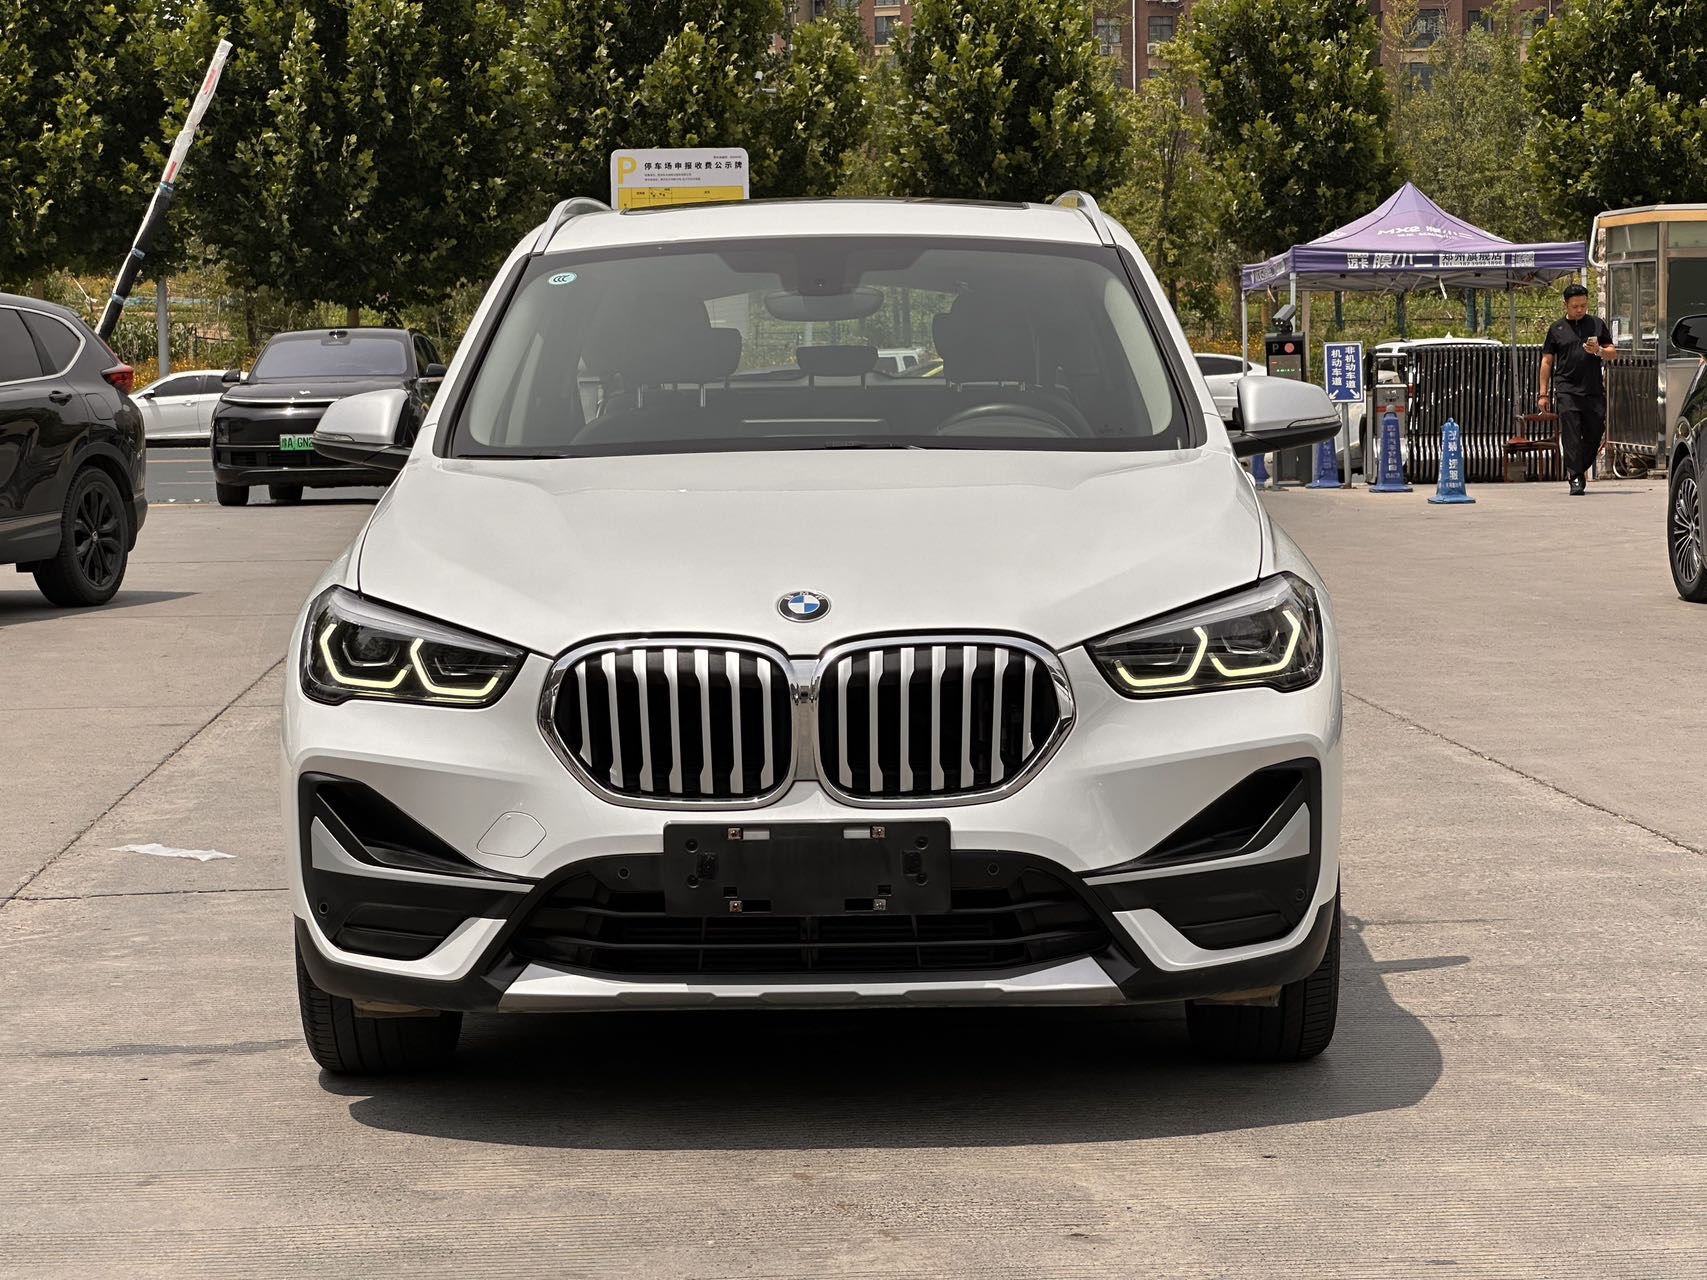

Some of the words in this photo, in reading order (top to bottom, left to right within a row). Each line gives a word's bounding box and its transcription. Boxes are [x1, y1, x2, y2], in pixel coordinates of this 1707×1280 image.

[618, 157, 637, 184] P
[644, 161, 743, 170] 停车场申报收费公示牌
[1373, 253, 1434, 269] 膜小二
[1272, 343, 1280, 353] P
[1331, 349, 1342, 386] 机动车道
[1345, 346, 1356, 389] 非机动车道
